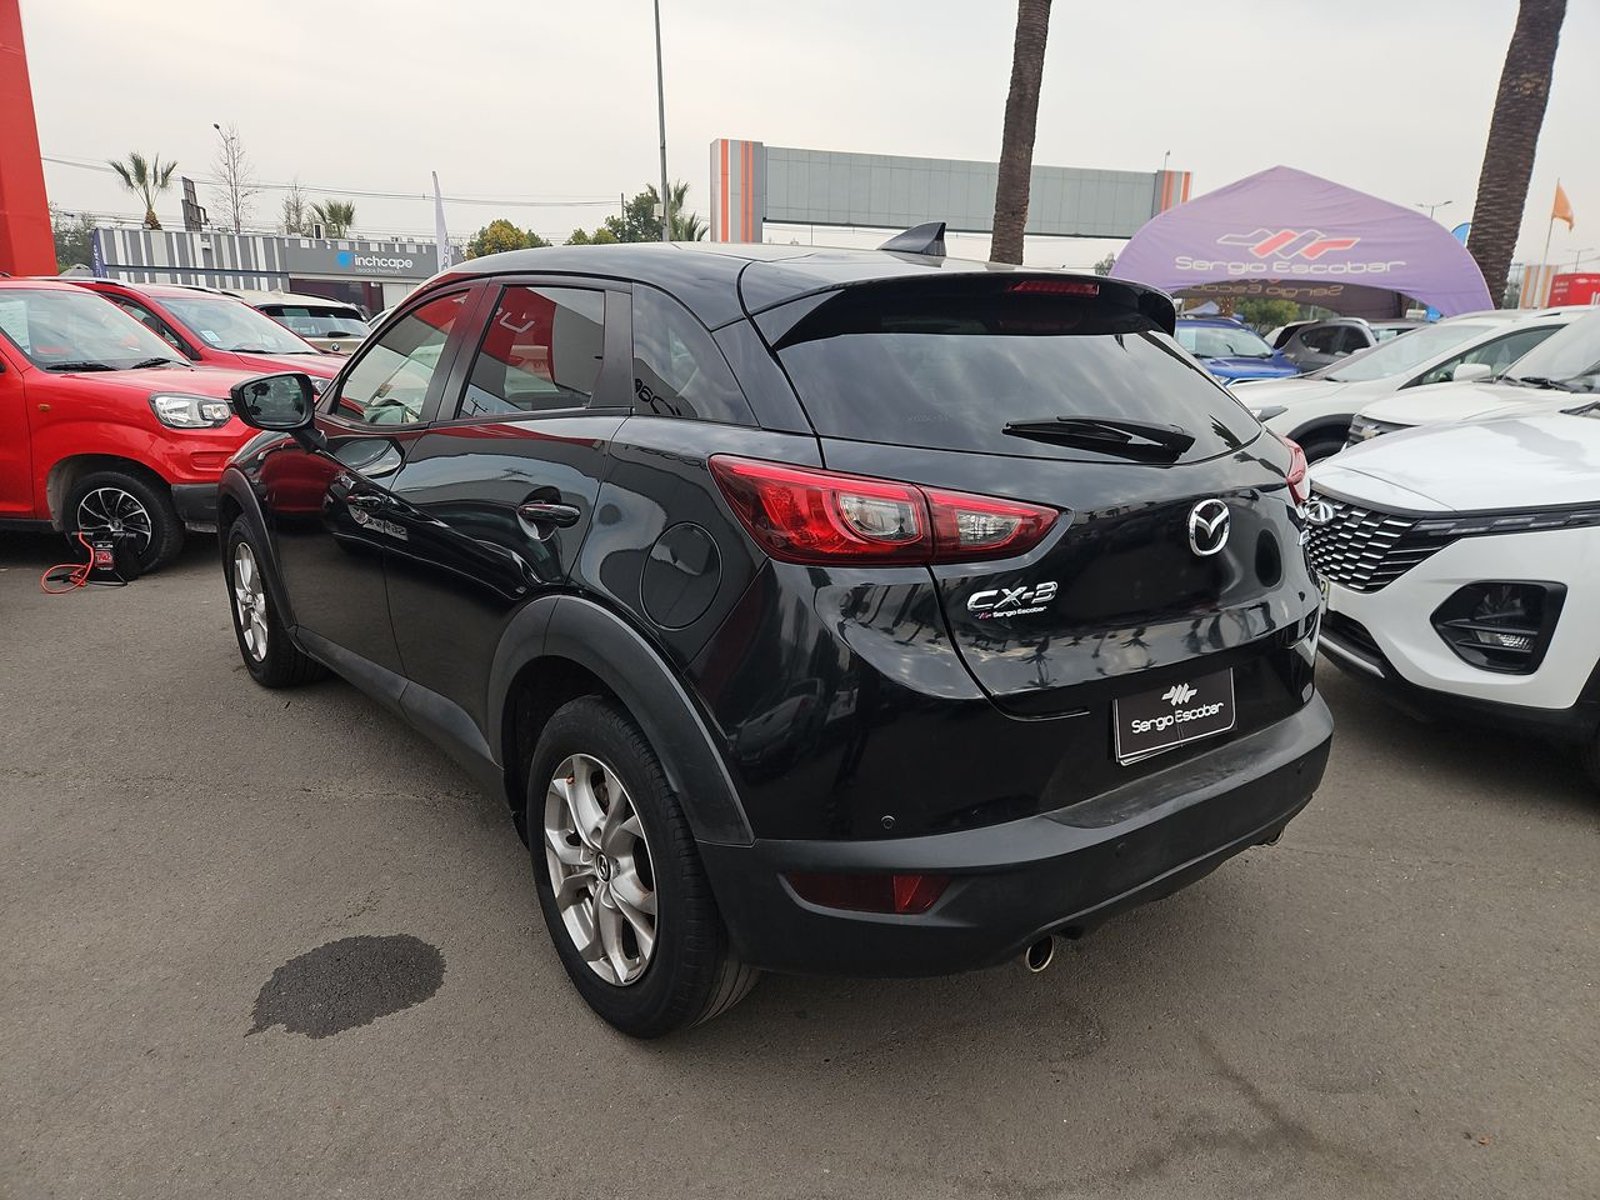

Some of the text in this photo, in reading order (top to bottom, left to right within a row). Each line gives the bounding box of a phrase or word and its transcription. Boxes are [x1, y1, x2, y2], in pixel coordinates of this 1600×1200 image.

[354, 254, 414, 270] inchcape
[1175, 255, 1408, 275] Sergio Escobar
[966, 581, 1059, 611] CX-3
[992, 605, 1047, 619] Sergio Escobar
[1131, 701, 1225, 734] Sergio Escobar
